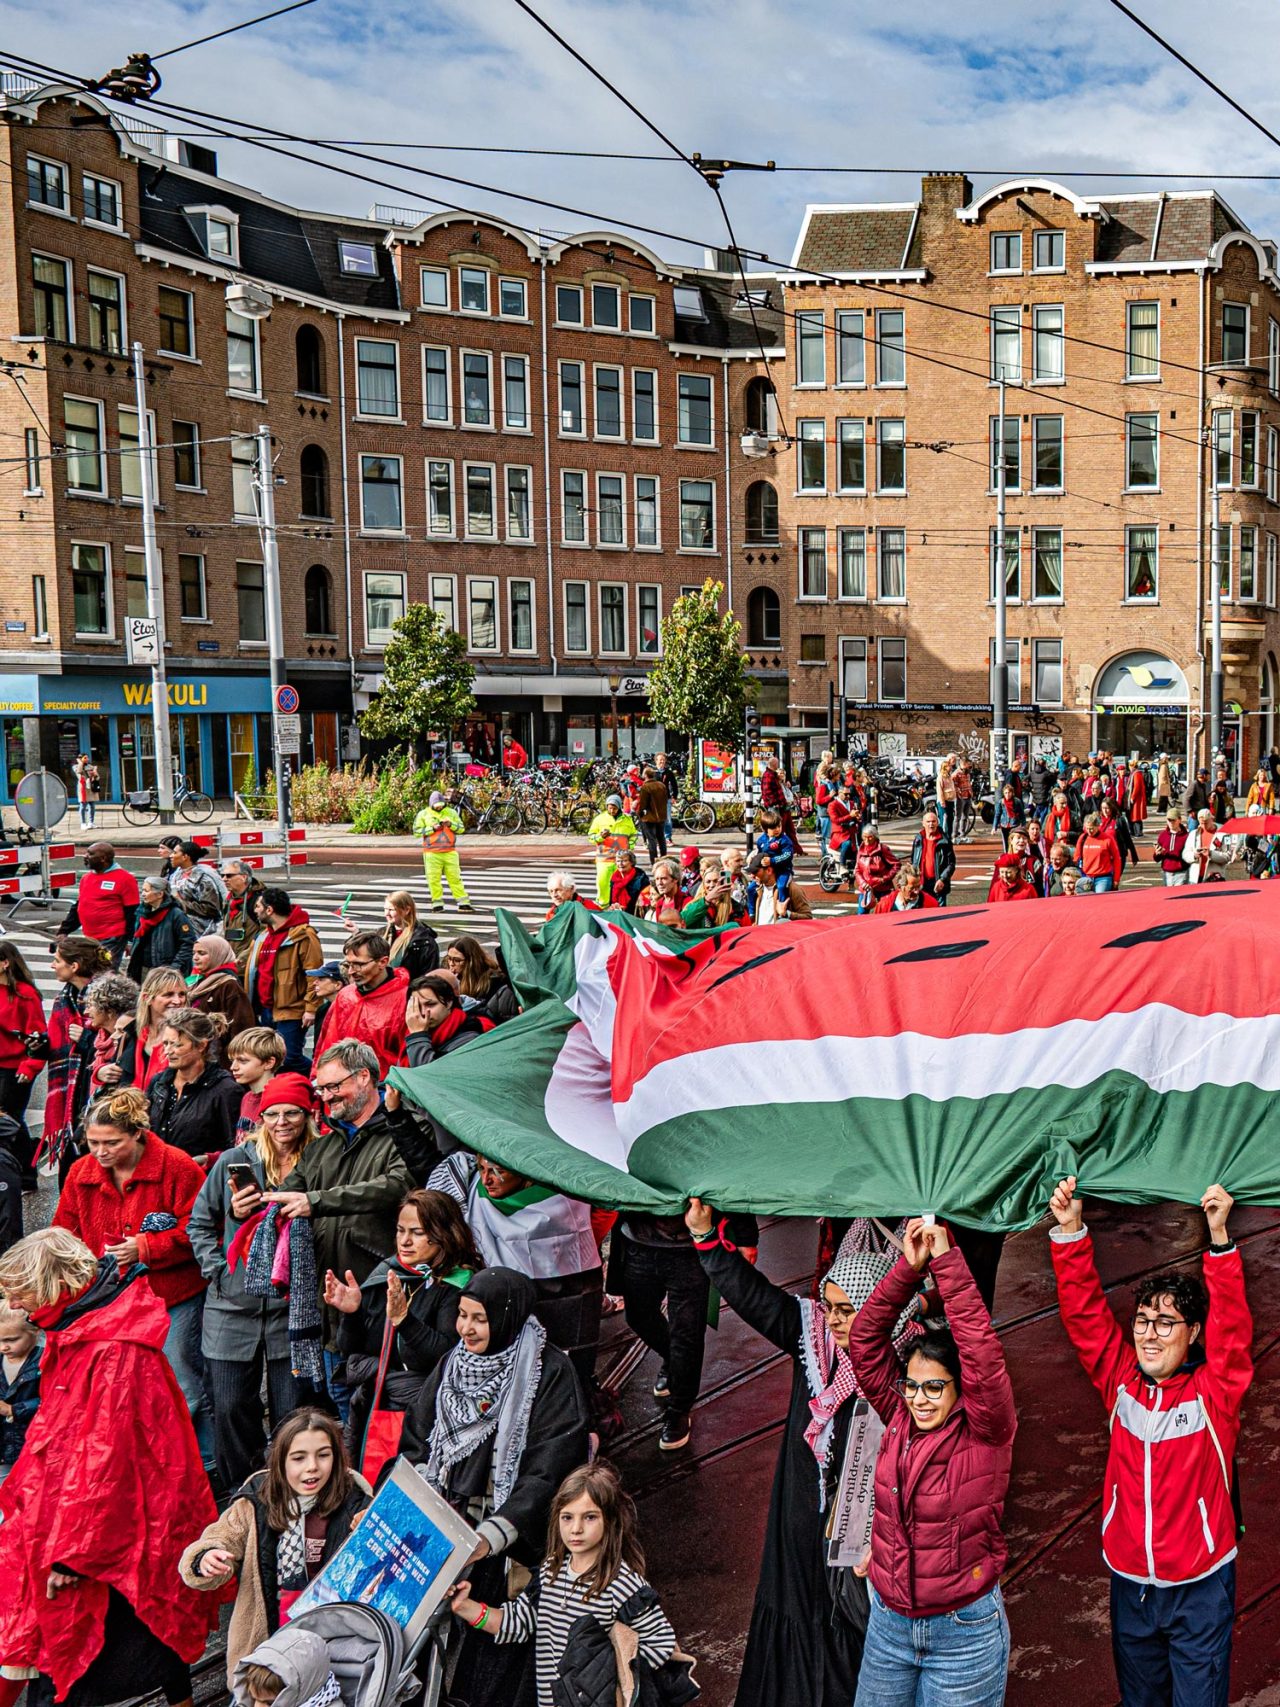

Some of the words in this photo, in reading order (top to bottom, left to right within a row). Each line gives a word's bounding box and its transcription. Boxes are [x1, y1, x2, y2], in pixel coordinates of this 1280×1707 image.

[132, 620, 156, 636] Etos
[10, 703, 34, 711] COFFEE
[44, 702, 76, 711] SPECIALTY
[76, 702, 101, 710] COFFEE
[123, 684, 207, 705] WAKULI
[838, 1505, 852, 1545] While
[845, 1446, 862, 1504] children
[856, 1421, 867, 1443] are
[857, 1464, 873, 1504] dying
[371, 1511, 381, 1523] WE
[391, 1533, 403, 1546] EEN
[401, 1543, 414, 1558] WEG
[863, 1521, 873, 1546] you
[373, 1528, 386, 1541] WE
[384, 1538, 401, 1558] GAAN
[399, 1554, 413, 1571] EEN
[411, 1568, 427, 1586] WEG
